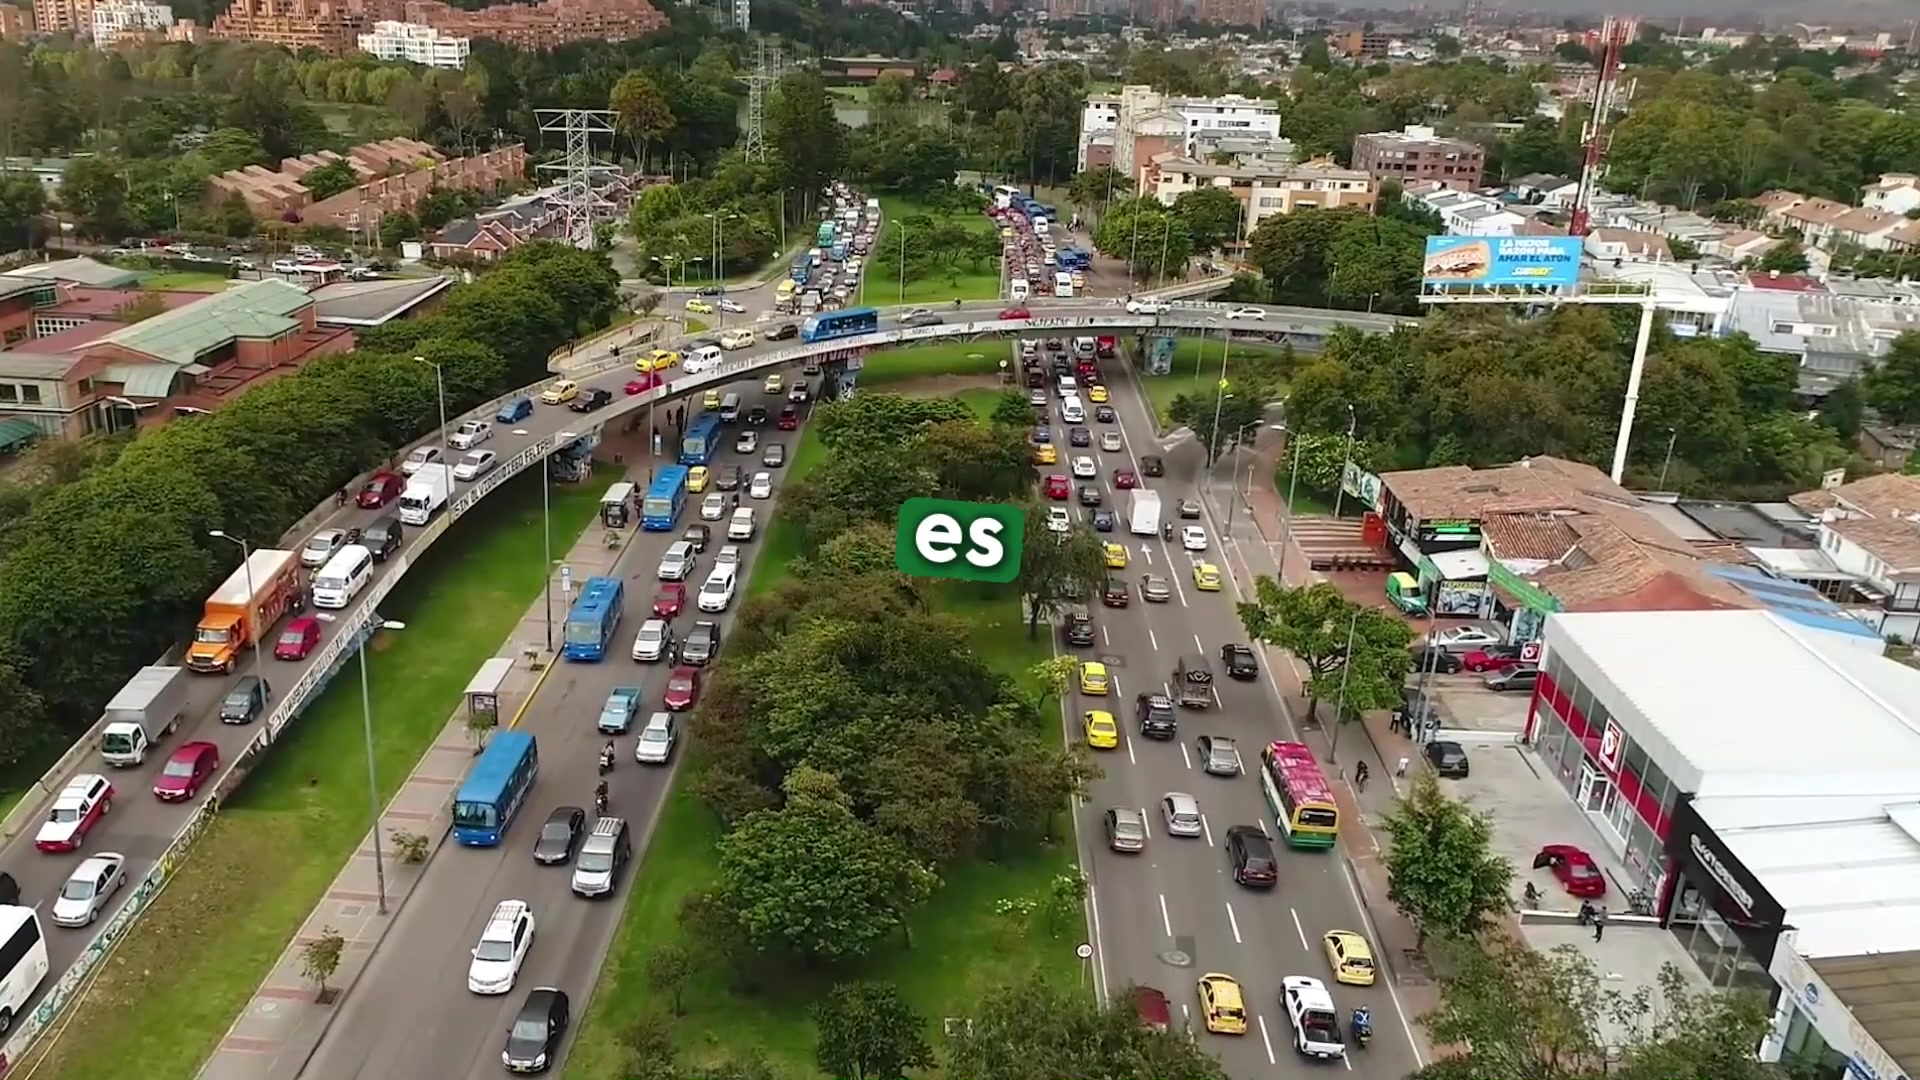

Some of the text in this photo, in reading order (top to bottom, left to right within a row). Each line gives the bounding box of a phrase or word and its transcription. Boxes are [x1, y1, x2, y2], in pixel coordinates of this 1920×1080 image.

[1499, 239, 1514, 247] LA
[1498, 255, 1528, 263] AMAR
[1528, 255, 1542, 263] EL
